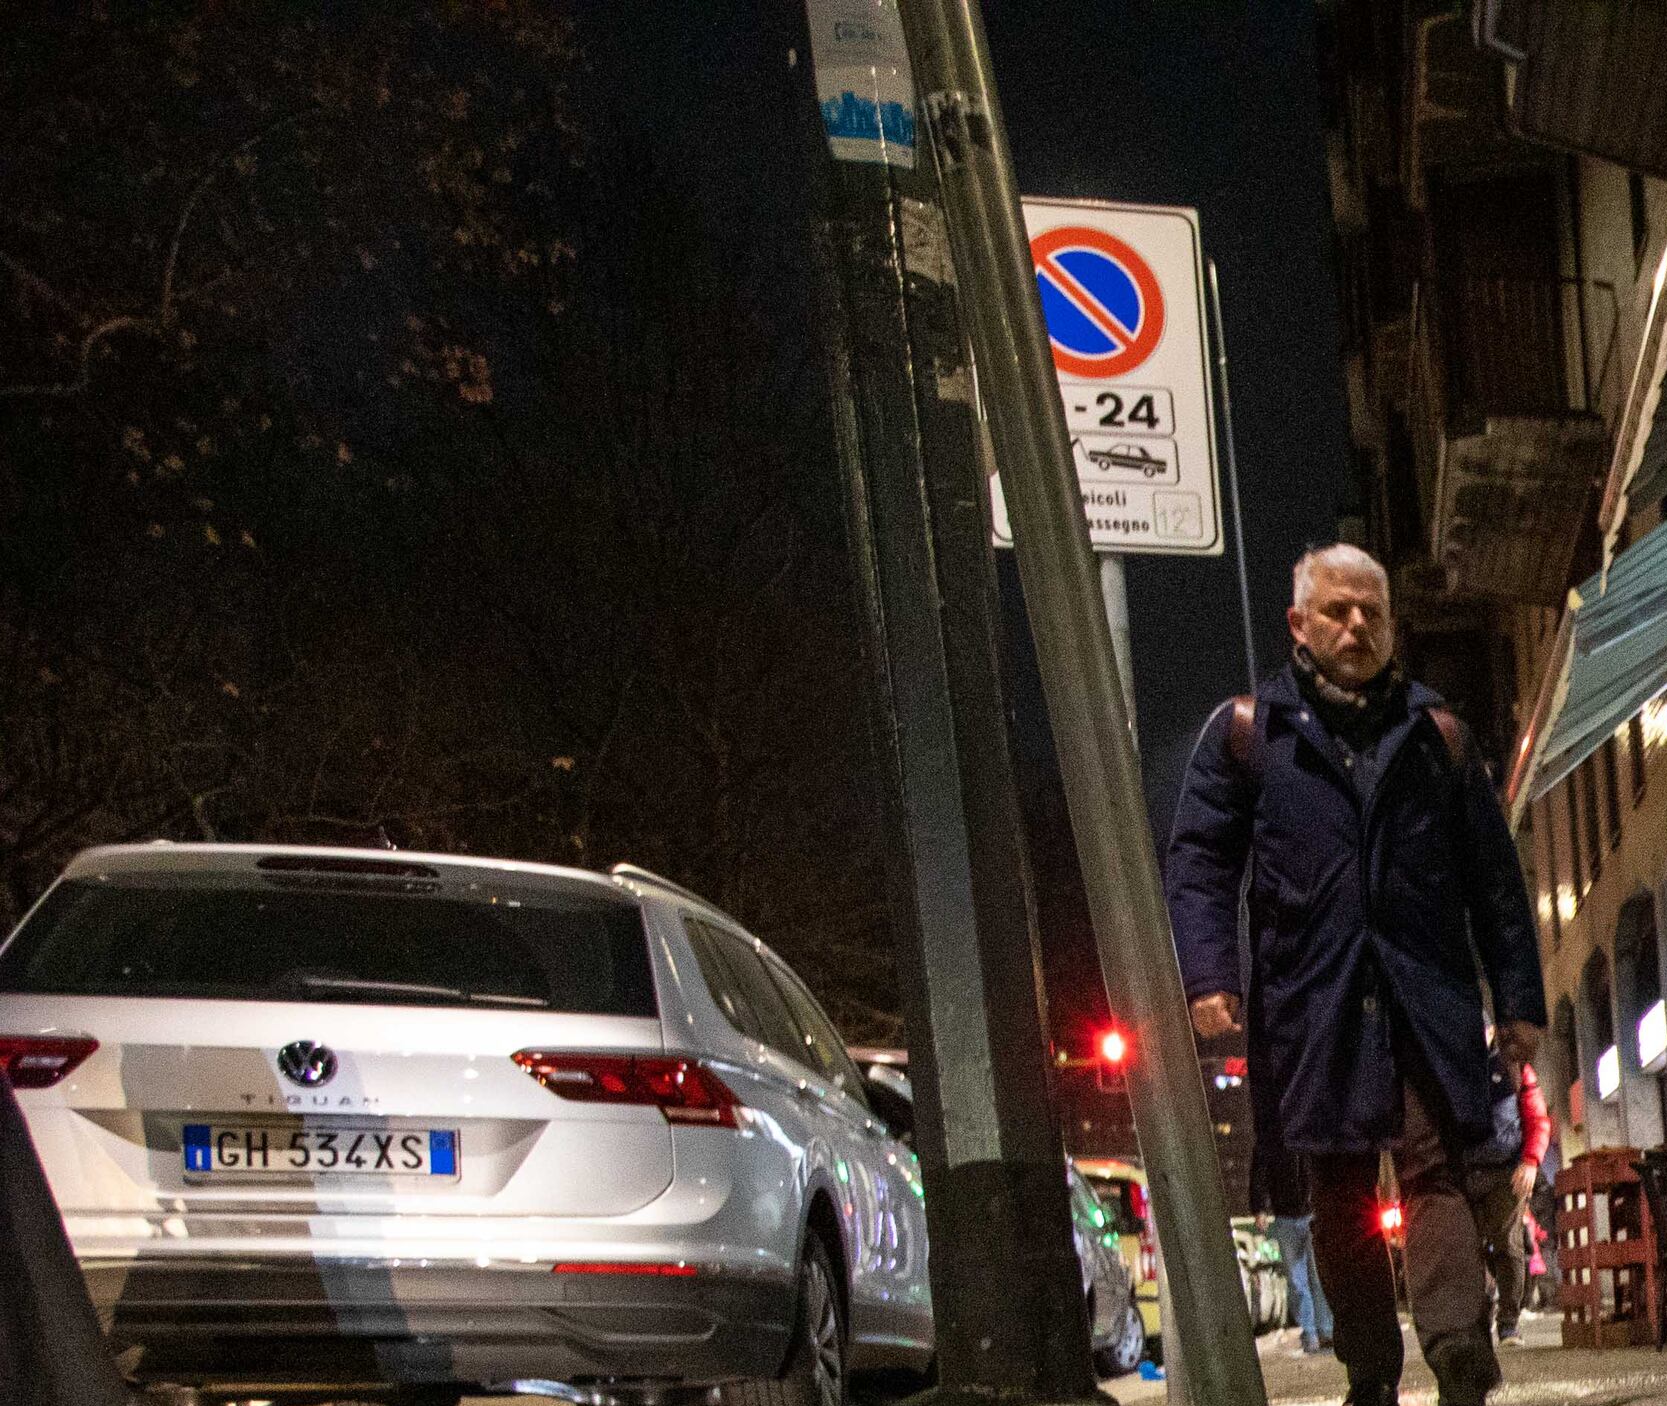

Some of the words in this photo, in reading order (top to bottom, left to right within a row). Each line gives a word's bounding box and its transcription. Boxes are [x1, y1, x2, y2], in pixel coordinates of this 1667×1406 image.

[1082, 490, 1127, 506] eicoli
[1087, 518, 1150, 534] assegno
[217, 1132, 269, 1168] GH
[288, 1133, 424, 1169] 534XS
